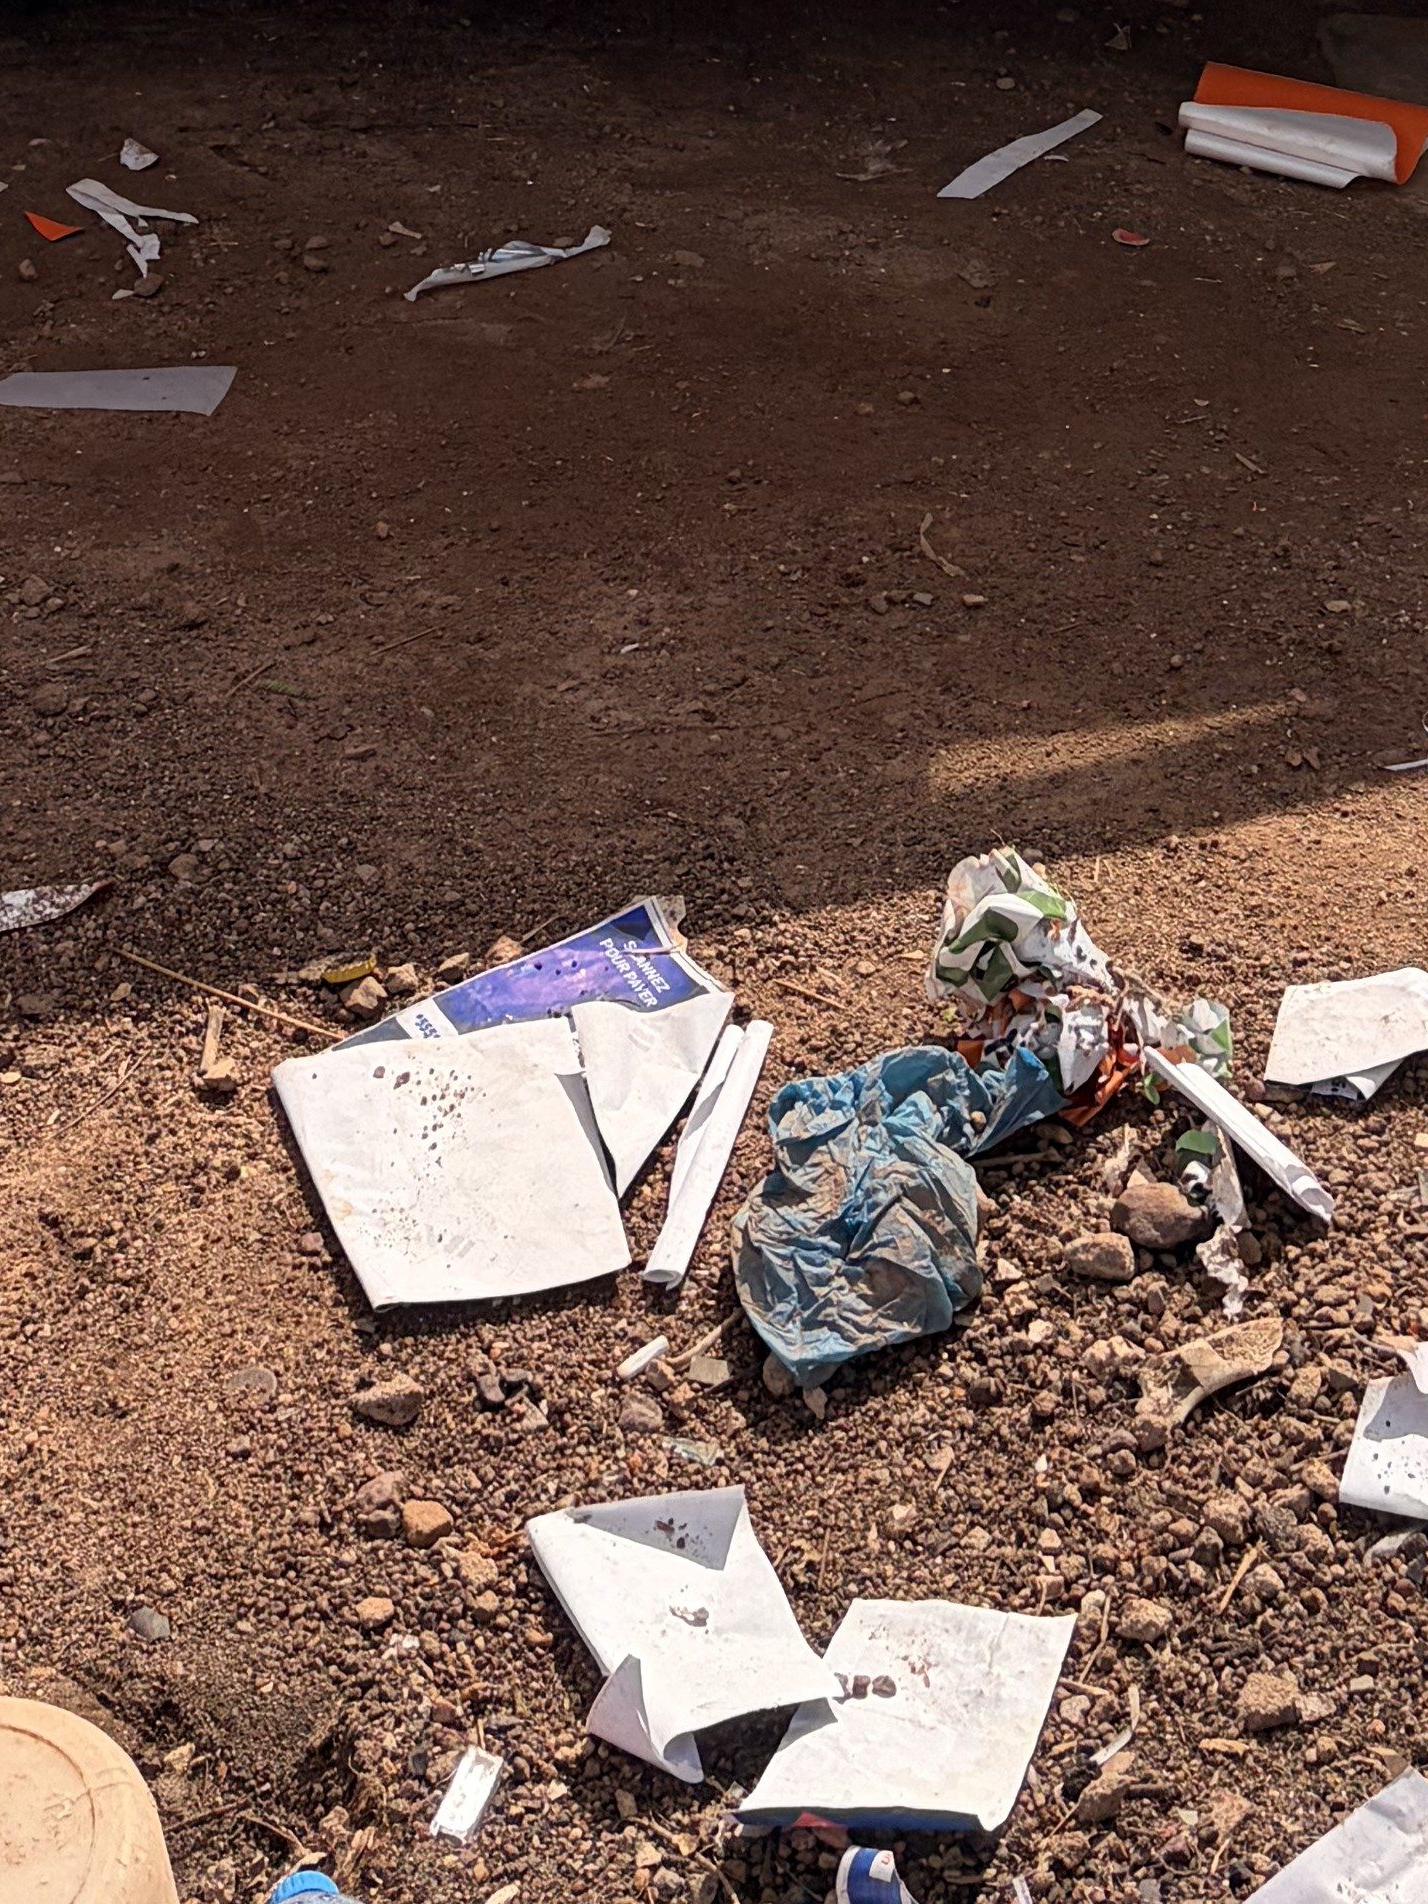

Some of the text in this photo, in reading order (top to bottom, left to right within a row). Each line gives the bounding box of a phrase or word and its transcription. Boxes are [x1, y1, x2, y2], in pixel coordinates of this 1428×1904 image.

[599, 937, 658, 1007] POUR PAYER
[623, 940, 671, 993] SANNEZ
